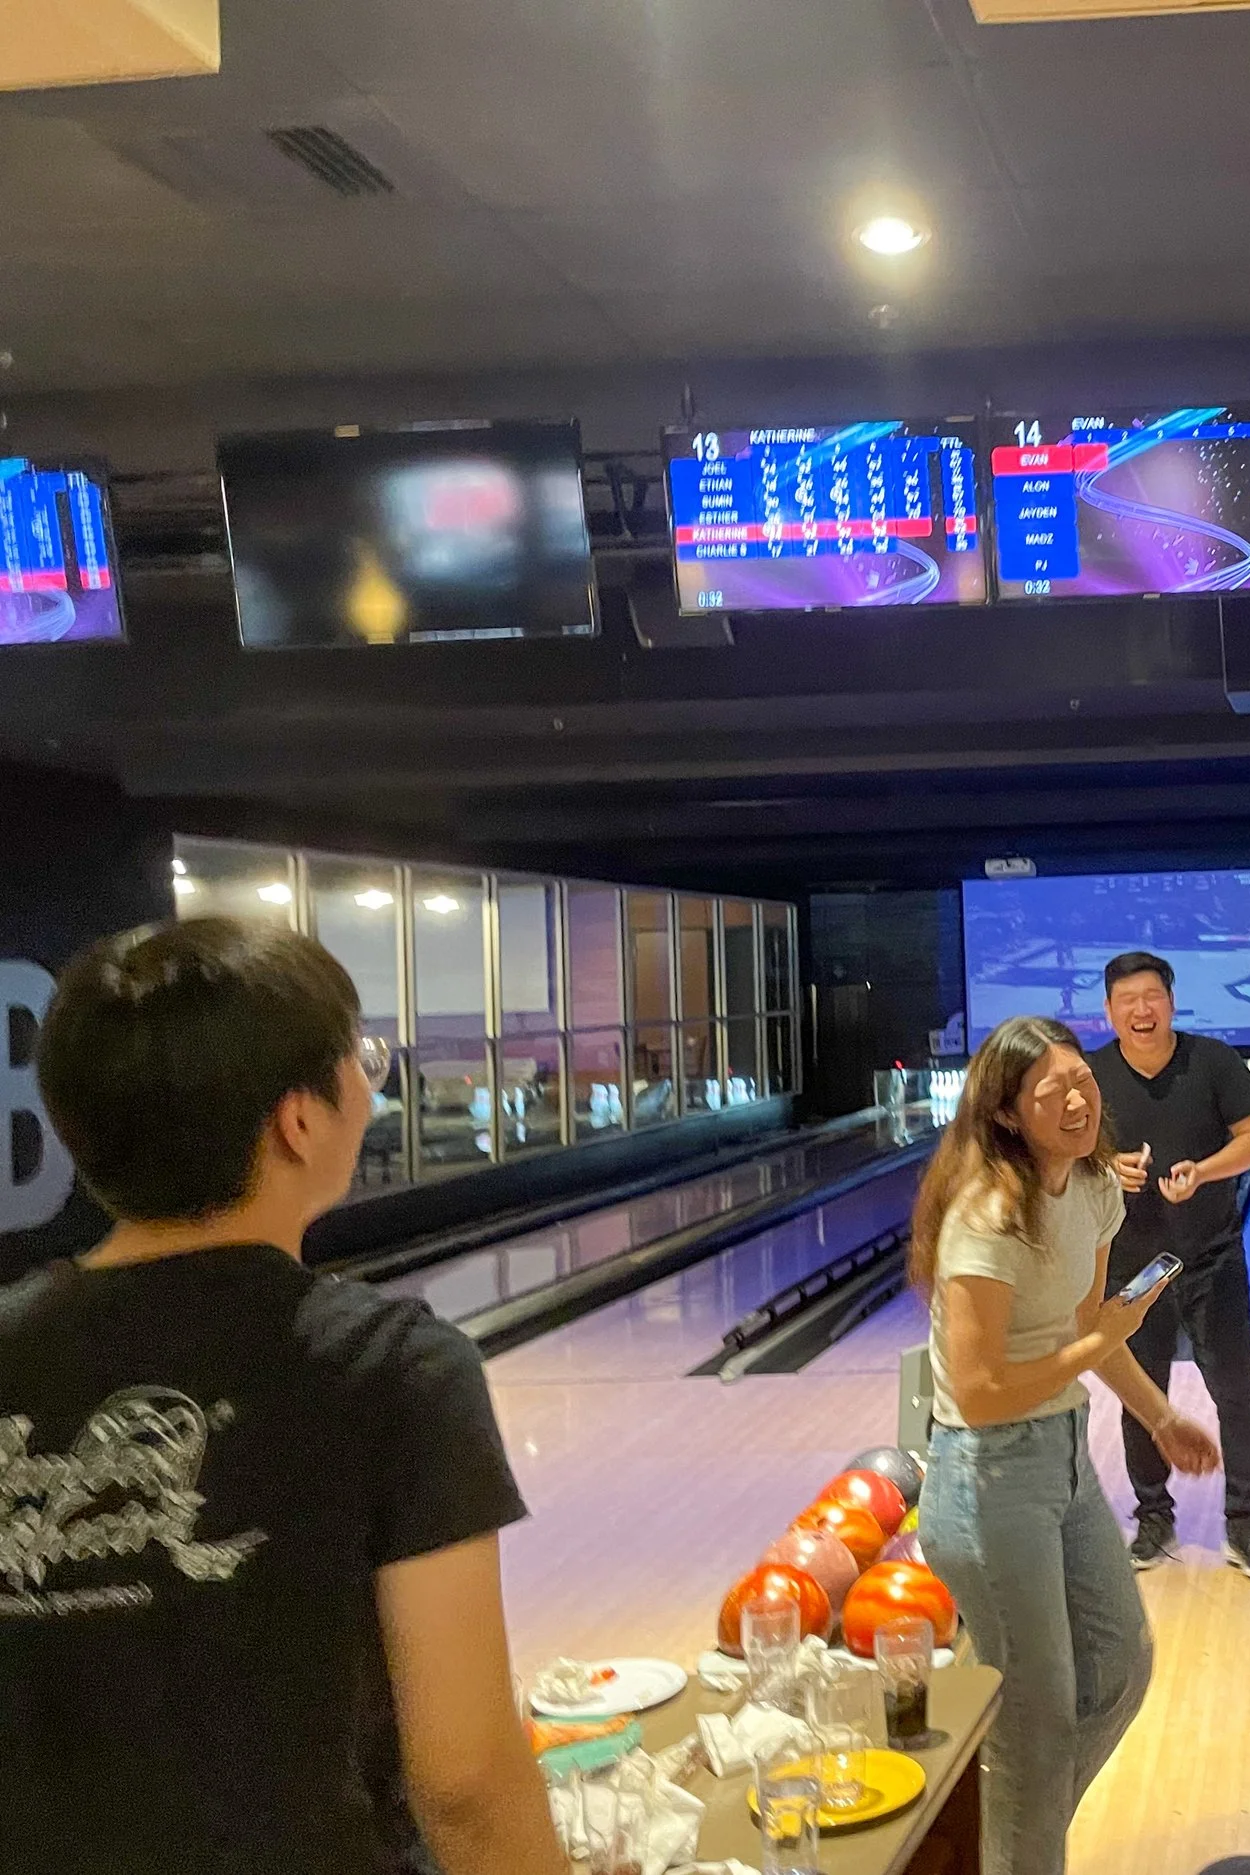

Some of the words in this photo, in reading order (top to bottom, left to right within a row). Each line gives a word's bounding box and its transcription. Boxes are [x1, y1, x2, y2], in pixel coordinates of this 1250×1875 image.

[1071, 417, 1105, 430] EVAN
[750, 428, 816, 445] KATHERINE
[1014, 420, 1042, 448] 14
[692, 432, 720, 462] 13
[1019, 454, 1049, 467] EVAN
[701, 461, 727, 476] JOEL
[699, 478, 733, 493] ETHAN
[699, 510, 739, 525] ESTHER
[1018, 506, 1058, 520] JAYDEN
[692, 527, 749, 542] KATHERINE
[696, 543, 738, 559] CHARLIE
[1024, 580, 1051, 595] 0:32
[0, 958, 76, 1233] B
